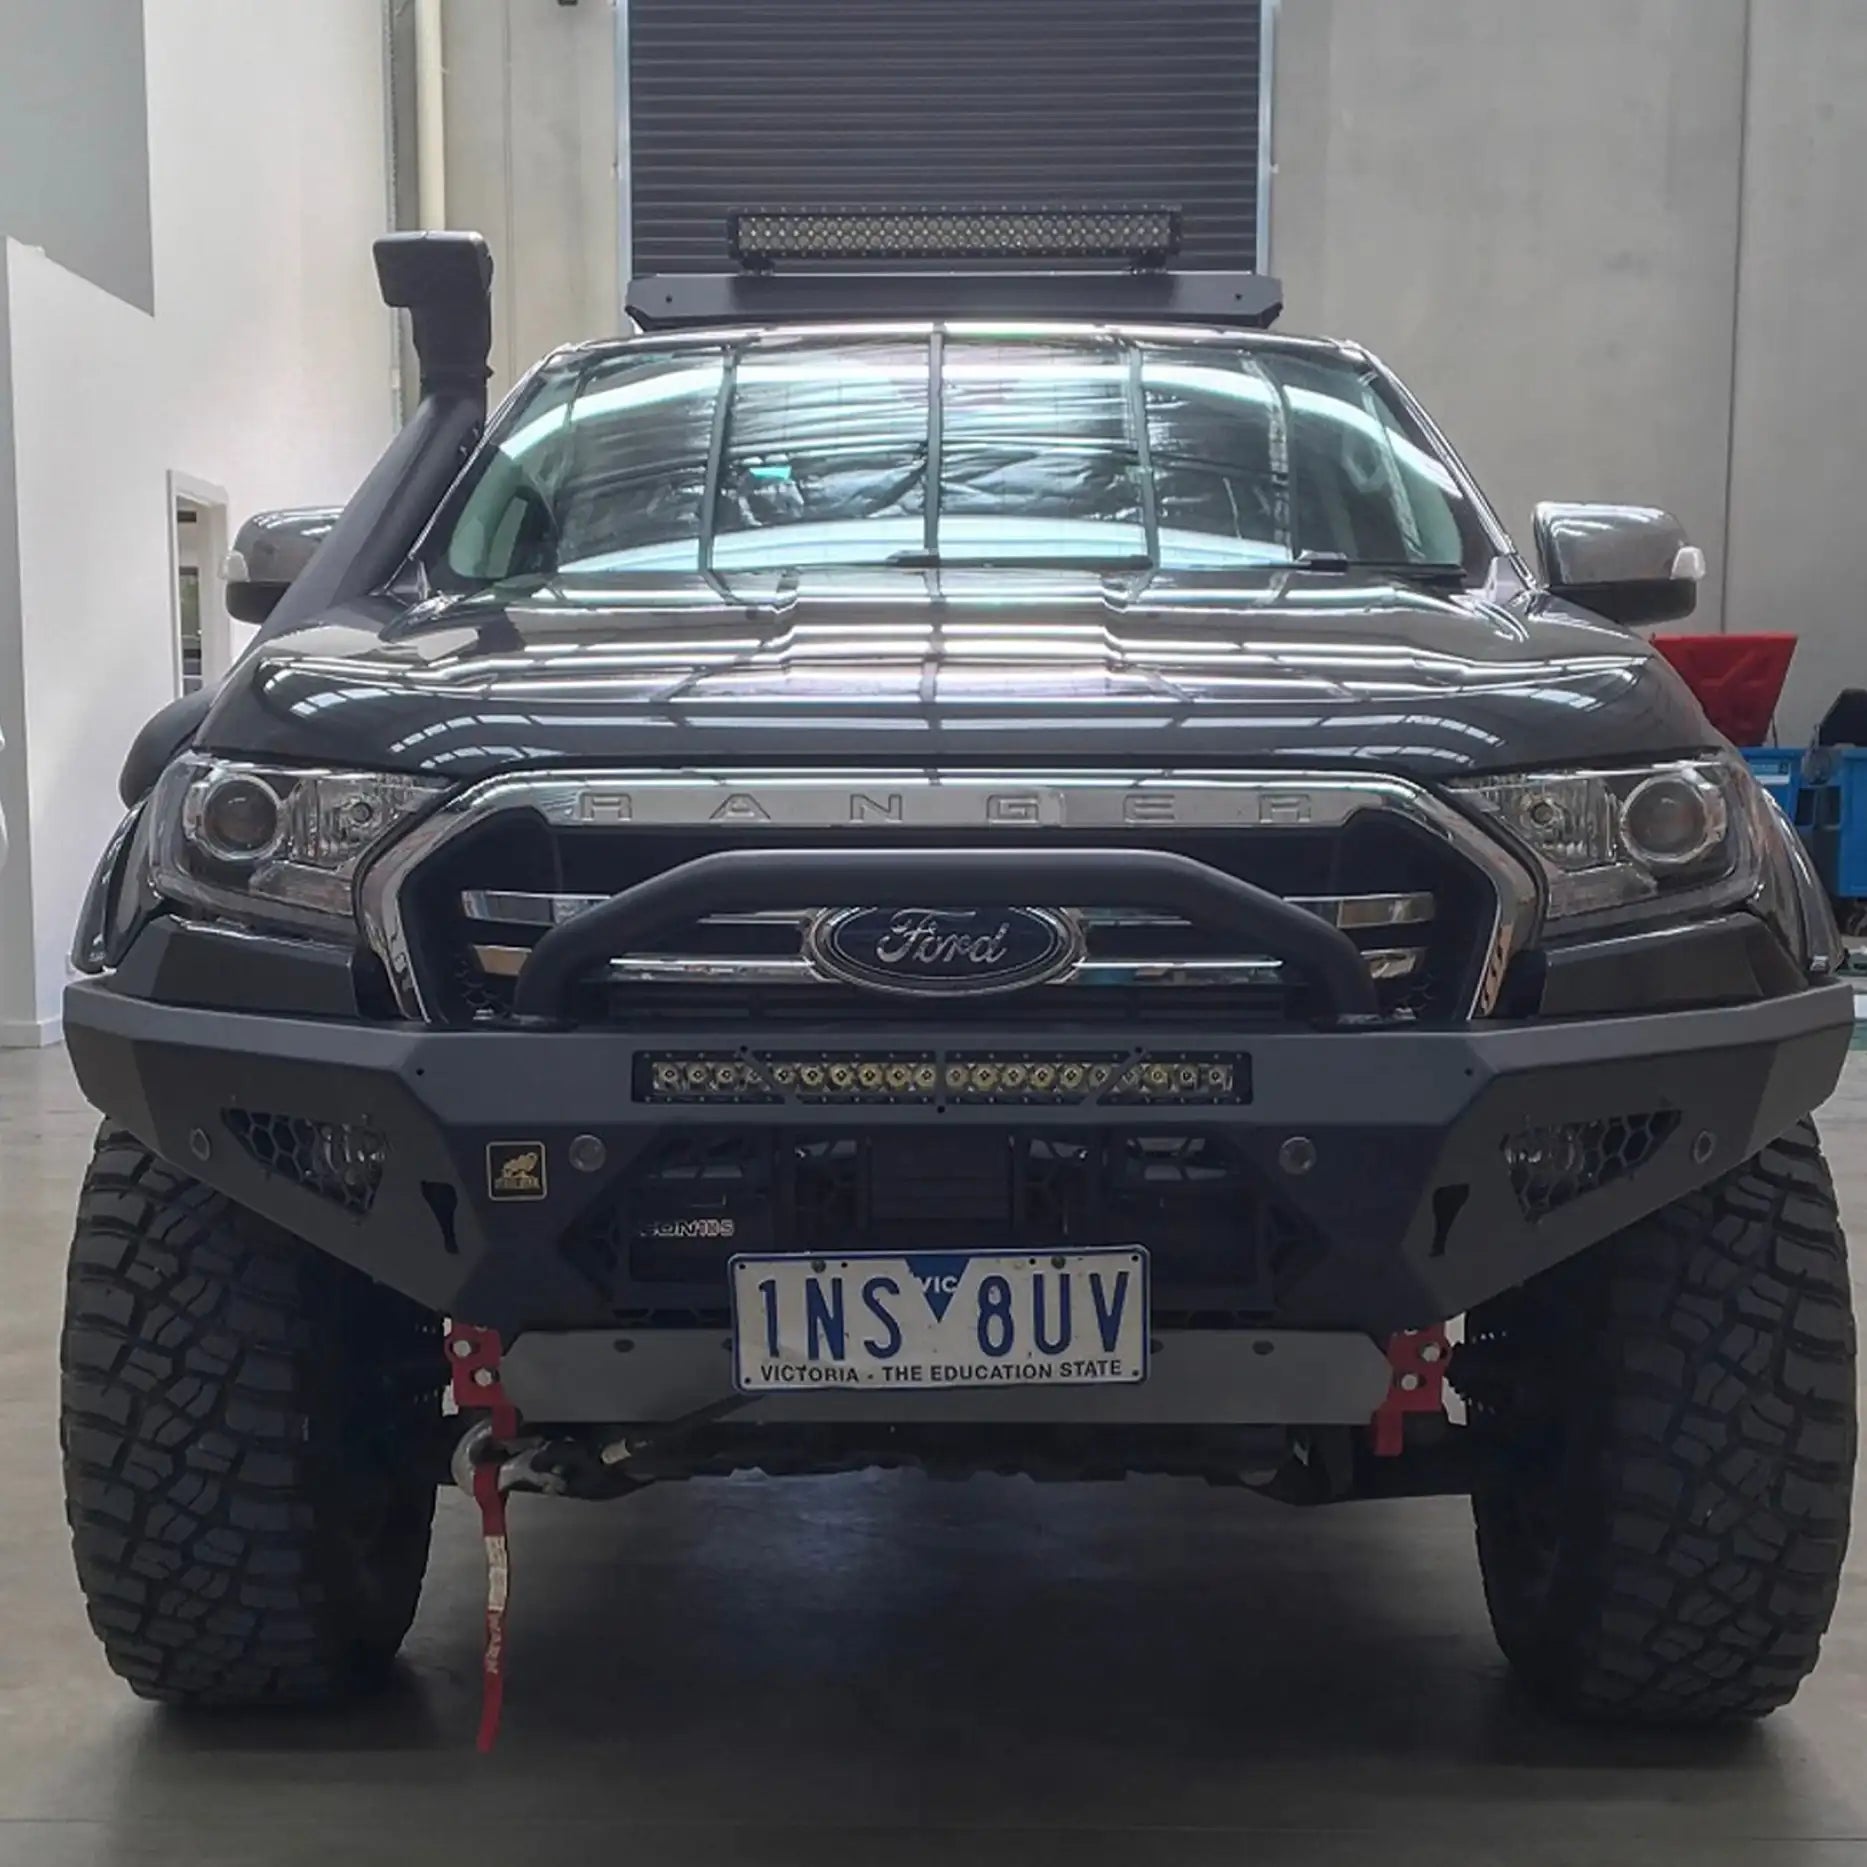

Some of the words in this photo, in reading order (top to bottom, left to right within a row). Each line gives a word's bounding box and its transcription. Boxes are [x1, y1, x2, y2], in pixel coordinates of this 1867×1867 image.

[578, 791, 1312, 823] RANGER
[876, 908, 1010, 965] Ford
[920, 1275, 958, 1293] VIC
[758, 1276, 903, 1361] 1NS
[977, 1271, 1129, 1357] 8UV
[760, 1364, 859, 1383] VICTORIA
[882, 1366, 924, 1382] THE
[930, 1364, 1052, 1380] EDUCATION
[1059, 1360, 1123, 1377] STATE
